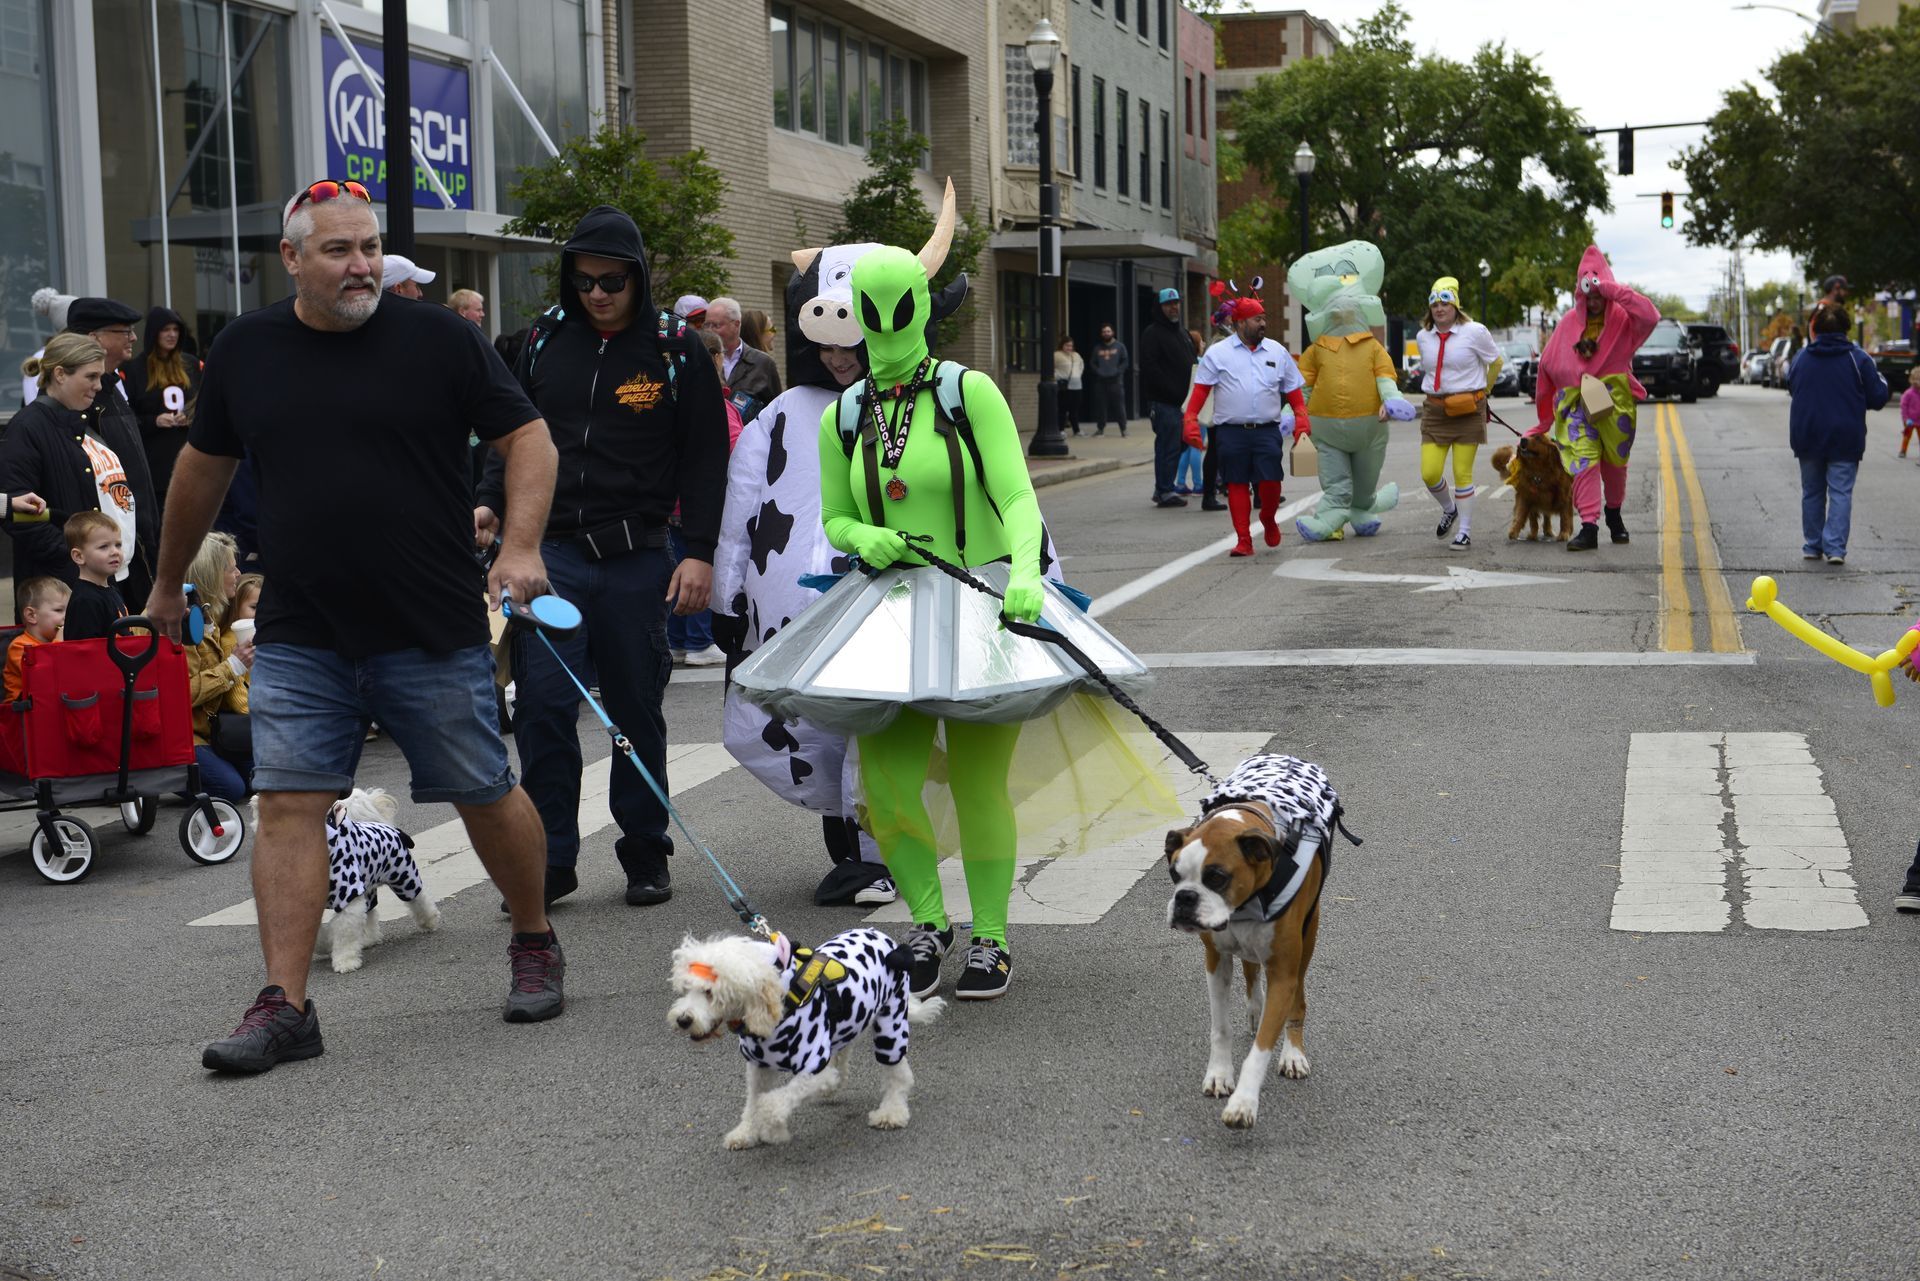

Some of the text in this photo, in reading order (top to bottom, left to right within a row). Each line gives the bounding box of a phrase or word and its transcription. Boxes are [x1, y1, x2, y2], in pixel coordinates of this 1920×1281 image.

[163, 385, 184, 413] 9
[615, 383, 664, 394] WORLD OF
[619, 391, 659, 403] WHEELS
[874, 404, 894, 459] SECOND
[893, 402, 914, 457] PLACE
